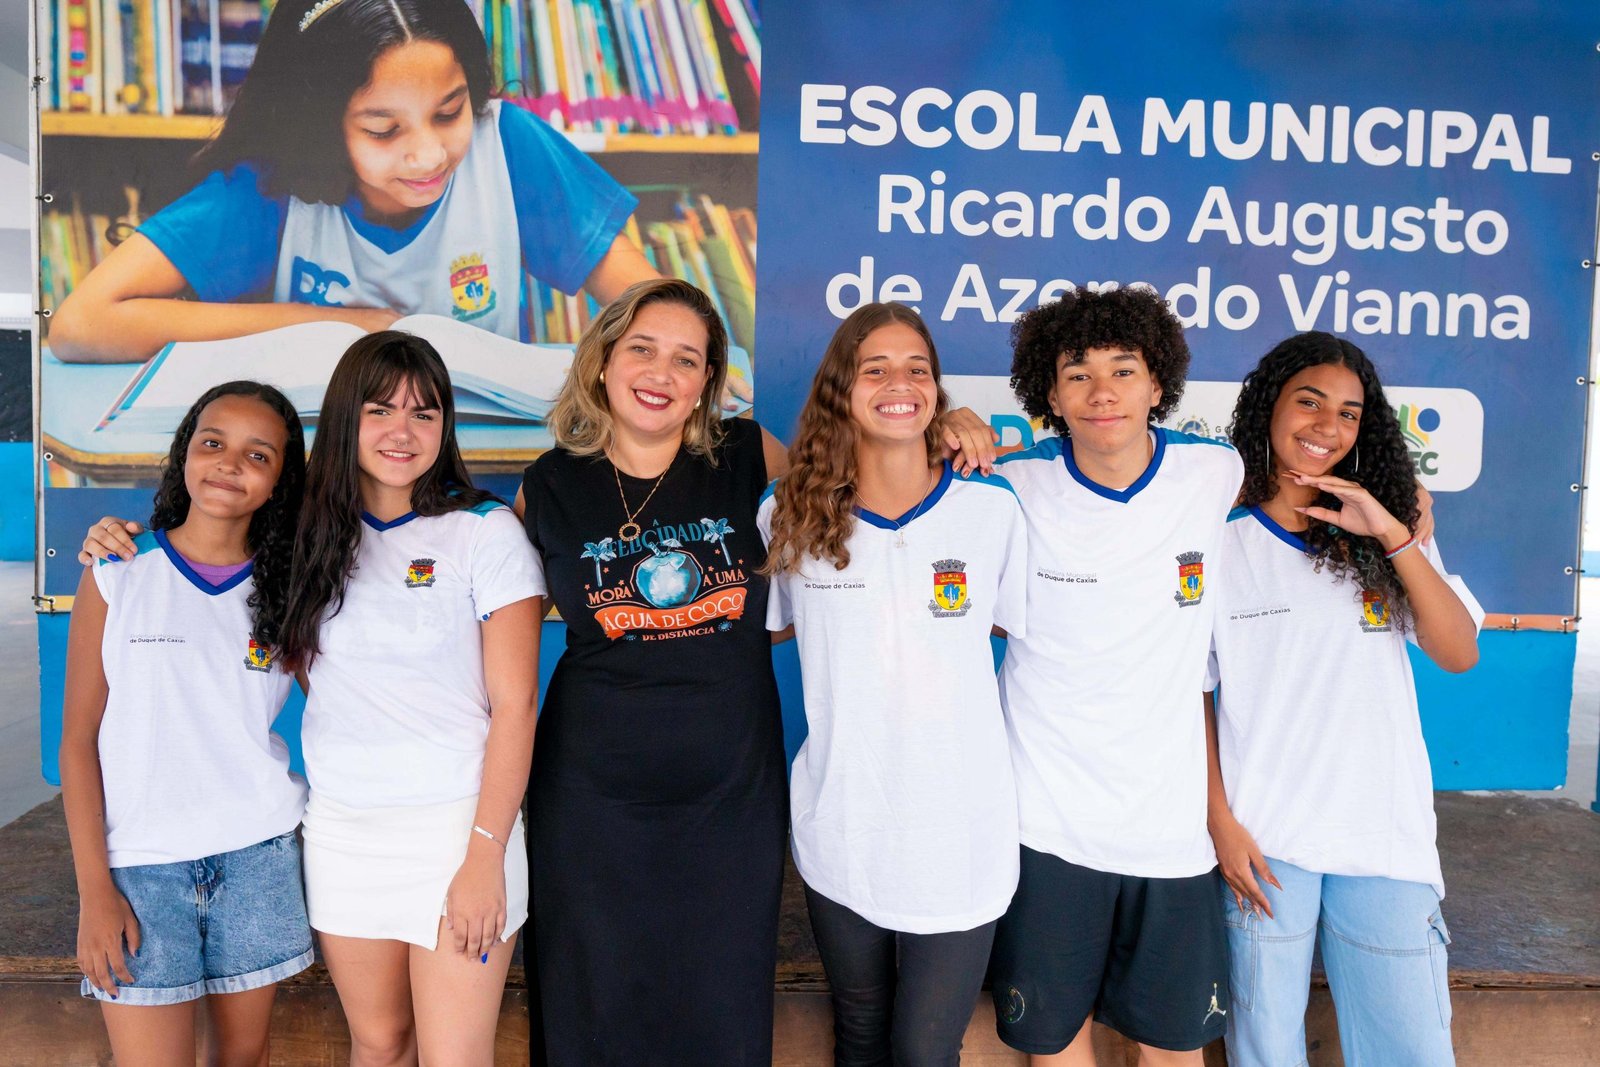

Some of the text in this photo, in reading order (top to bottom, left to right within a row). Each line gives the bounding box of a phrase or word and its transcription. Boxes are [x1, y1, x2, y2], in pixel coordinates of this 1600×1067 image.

[799, 83, 1572, 175] ESCOLA MUNICIPAL
[877, 170, 1510, 266] Ricardo Augusto
[825, 255, 1531, 341] de Azedo Vianna
[588, 569, 744, 605] MORA A UMA
[1044, 574, 1064, 582] Duque
[1076, 576, 1098, 584] Caxias
[662, 613, 688, 628] DE
[687, 592, 744, 623] COCO
